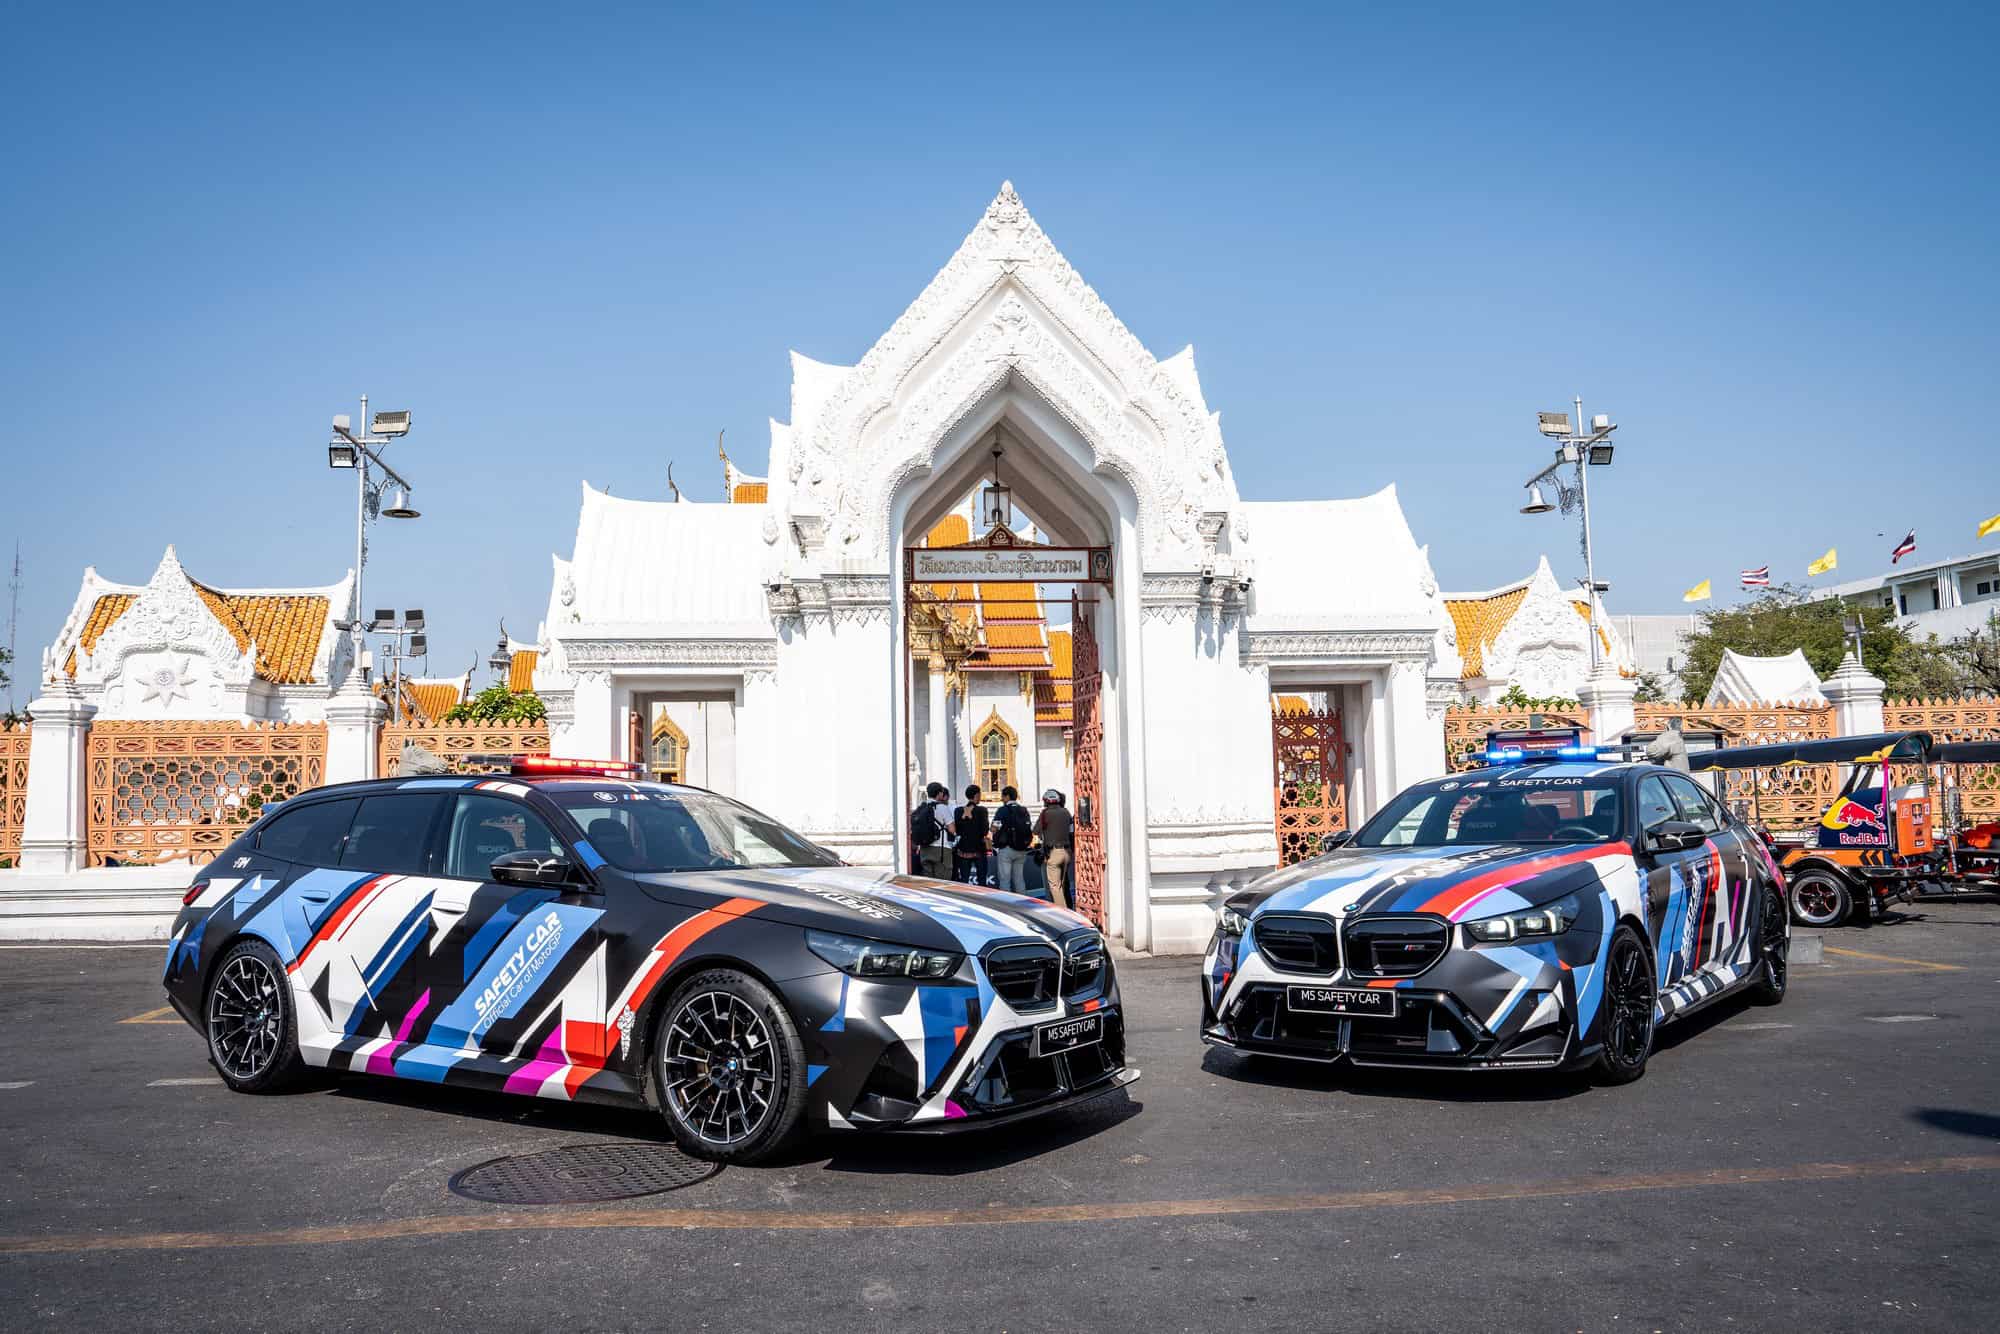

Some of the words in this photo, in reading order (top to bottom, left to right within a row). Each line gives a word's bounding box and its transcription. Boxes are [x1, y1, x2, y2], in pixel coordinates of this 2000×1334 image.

[1499, 779, 1551, 787] SAFETY
[474, 945, 526, 1017] SAFETY
[526, 911, 561, 952] CAR
[483, 997, 513, 1030] Official
[509, 980, 525, 998] Car
[523, 967, 534, 984] of
[531, 931, 562, 974] MotoGP
[1317, 991, 1357, 1003] SAFETY
[1358, 993, 1381, 1004] CAR
[1058, 1021, 1084, 1040] SAFETY
[1082, 1018, 1097, 1033] CAR
